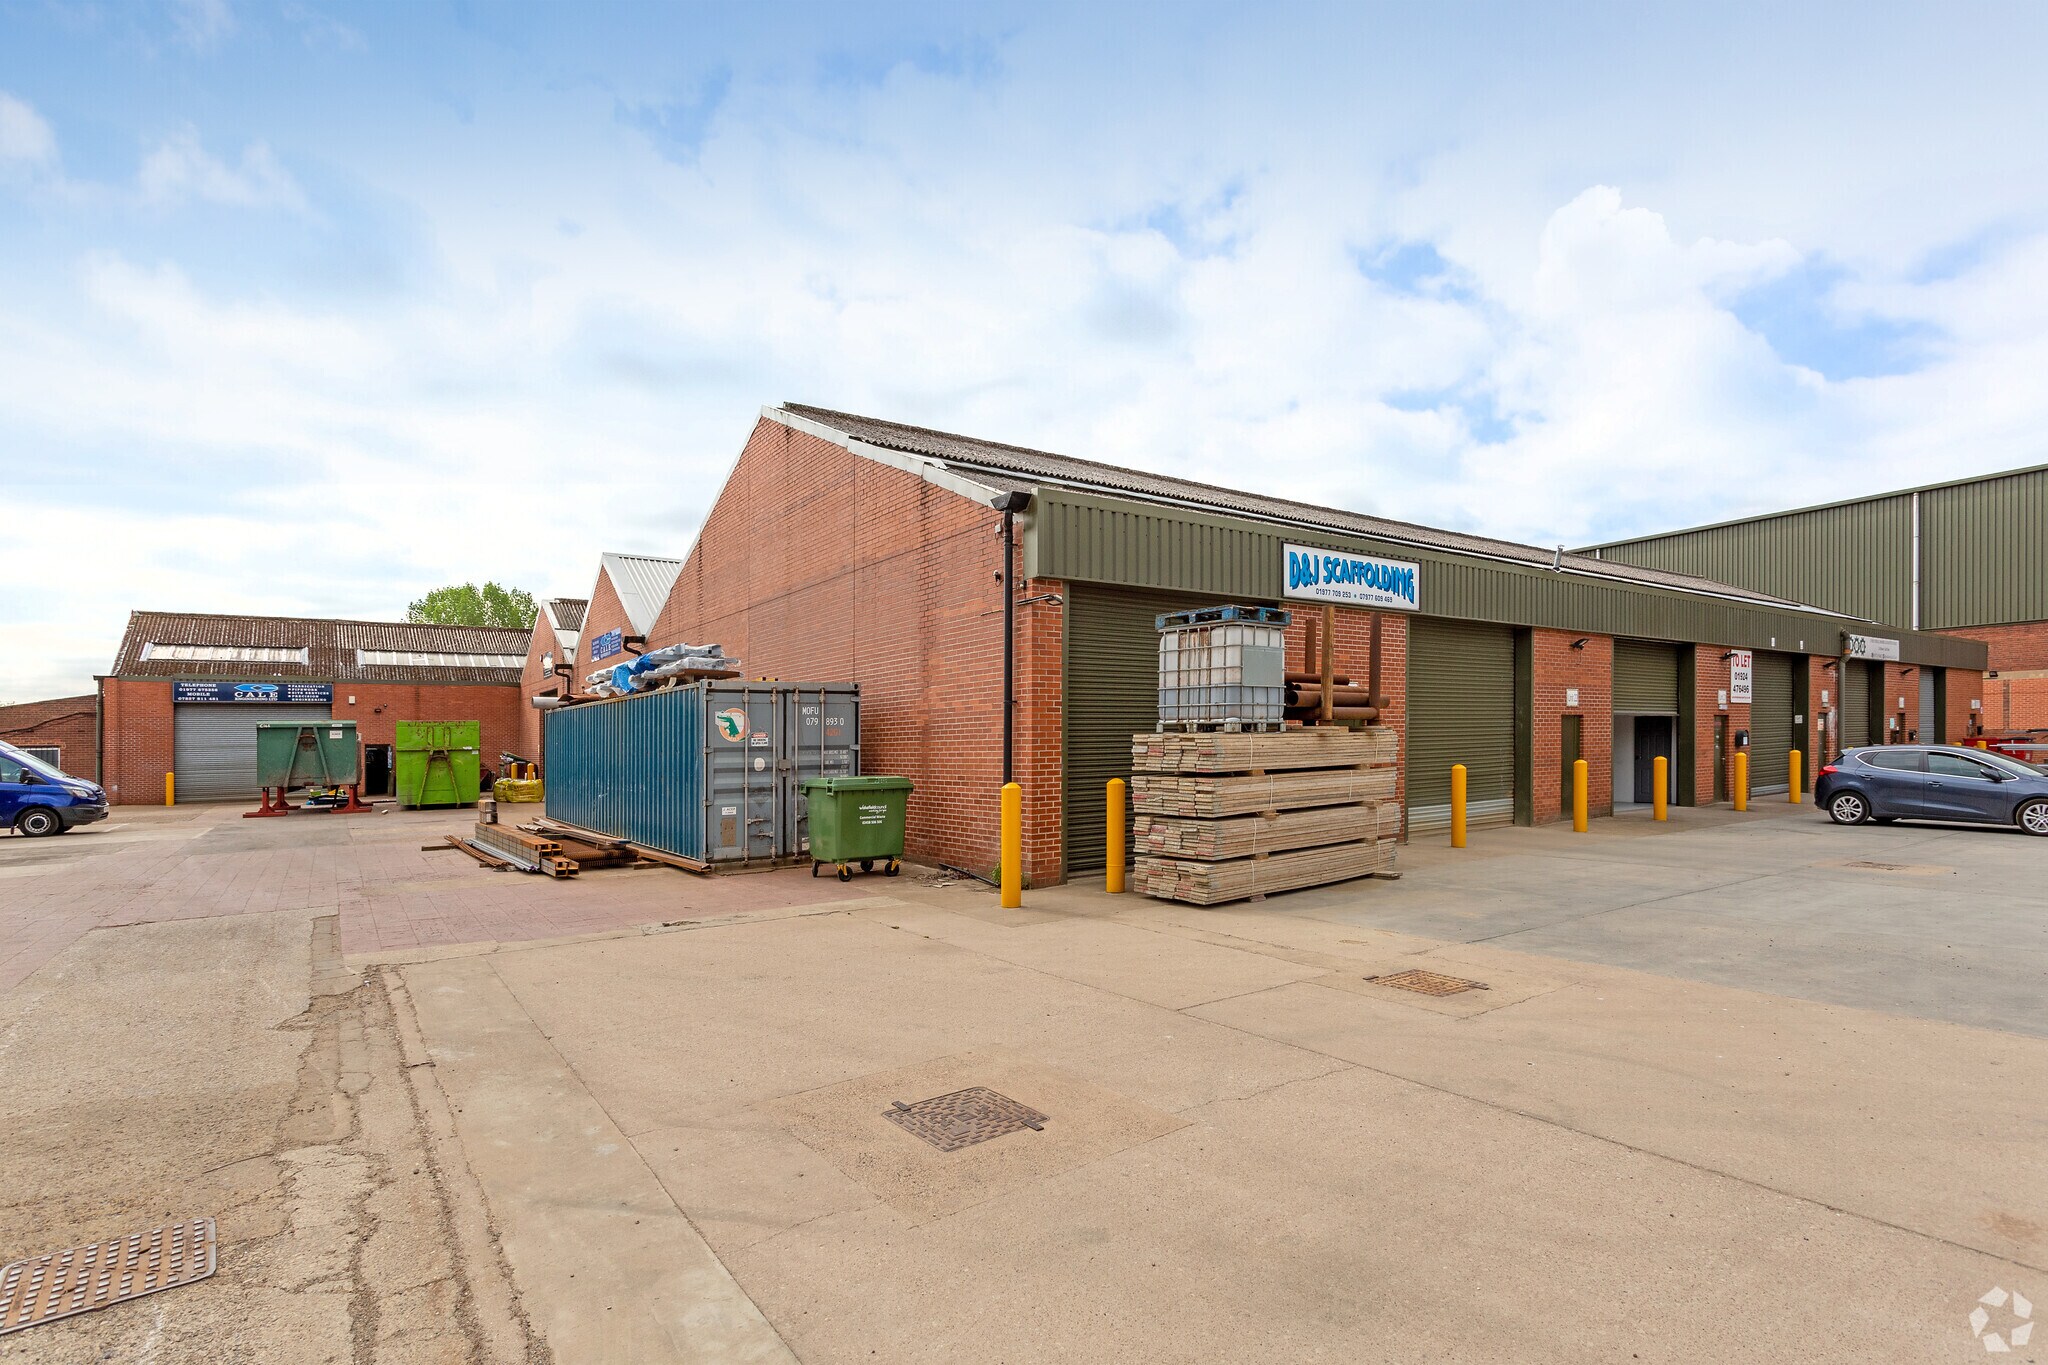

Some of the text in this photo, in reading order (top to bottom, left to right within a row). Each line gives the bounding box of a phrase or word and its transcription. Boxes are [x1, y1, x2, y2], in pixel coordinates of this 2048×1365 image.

[1289, 551, 1415, 604] D&J SCAFFOLDING
[1315, 588, 1331, 596] 01977
[1359, 593, 1374, 601] 07977
[1732, 654, 1751, 668] TO LET
[802, 706, 819, 715] MOFU
[805, 717, 845, 726] 079 893 0
